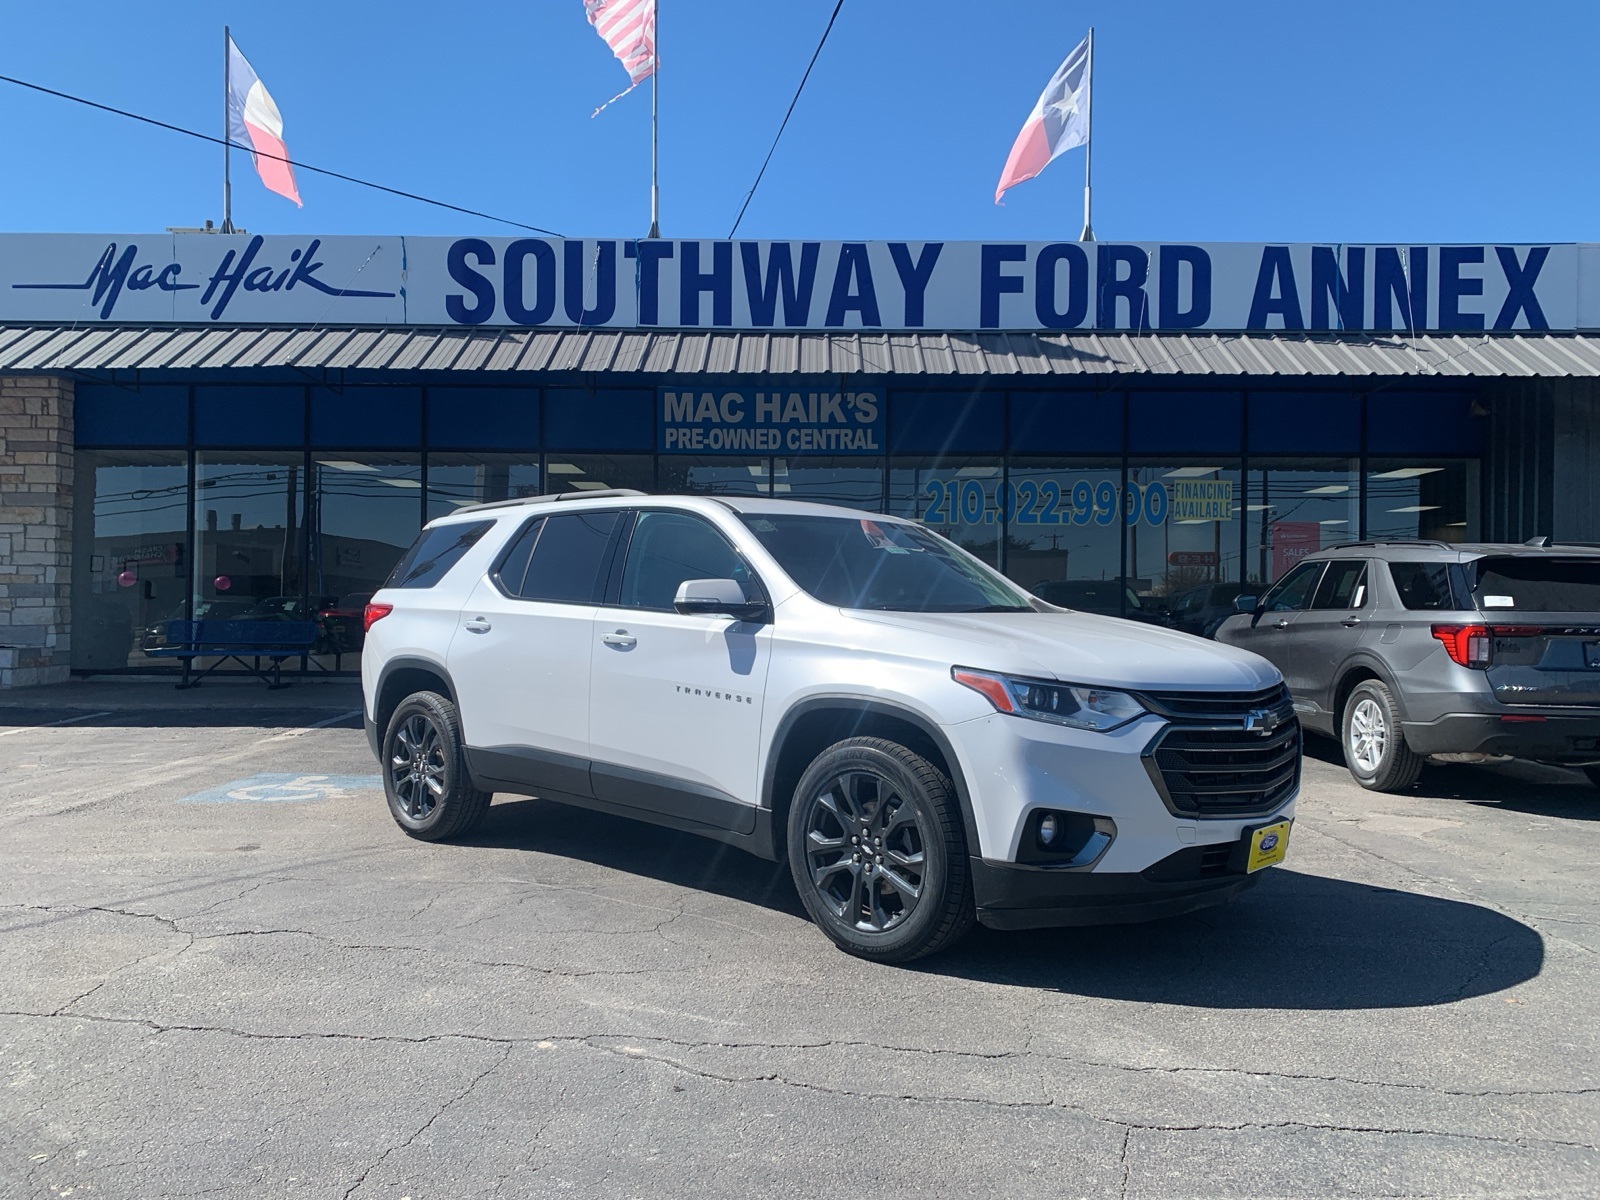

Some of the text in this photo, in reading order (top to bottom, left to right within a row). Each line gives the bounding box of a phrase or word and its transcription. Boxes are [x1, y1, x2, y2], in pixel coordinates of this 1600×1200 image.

[12, 234, 396, 321] Mac Haik
[445, 237, 1552, 331] SOUTHWAY FORD ANNEX
[664, 392, 879, 423] MAC HAIK'S
[665, 427, 879, 450] PRE-OWNED CENTRAL
[1175, 482, 1231, 499] FINANCING
[922, 479, 1169, 527] 210.922.9900
[1174, 501, 1231, 518] AVAILABLE
[1283, 548, 1310, 556] SALES
[676, 685, 753, 704] TRAVERSE
